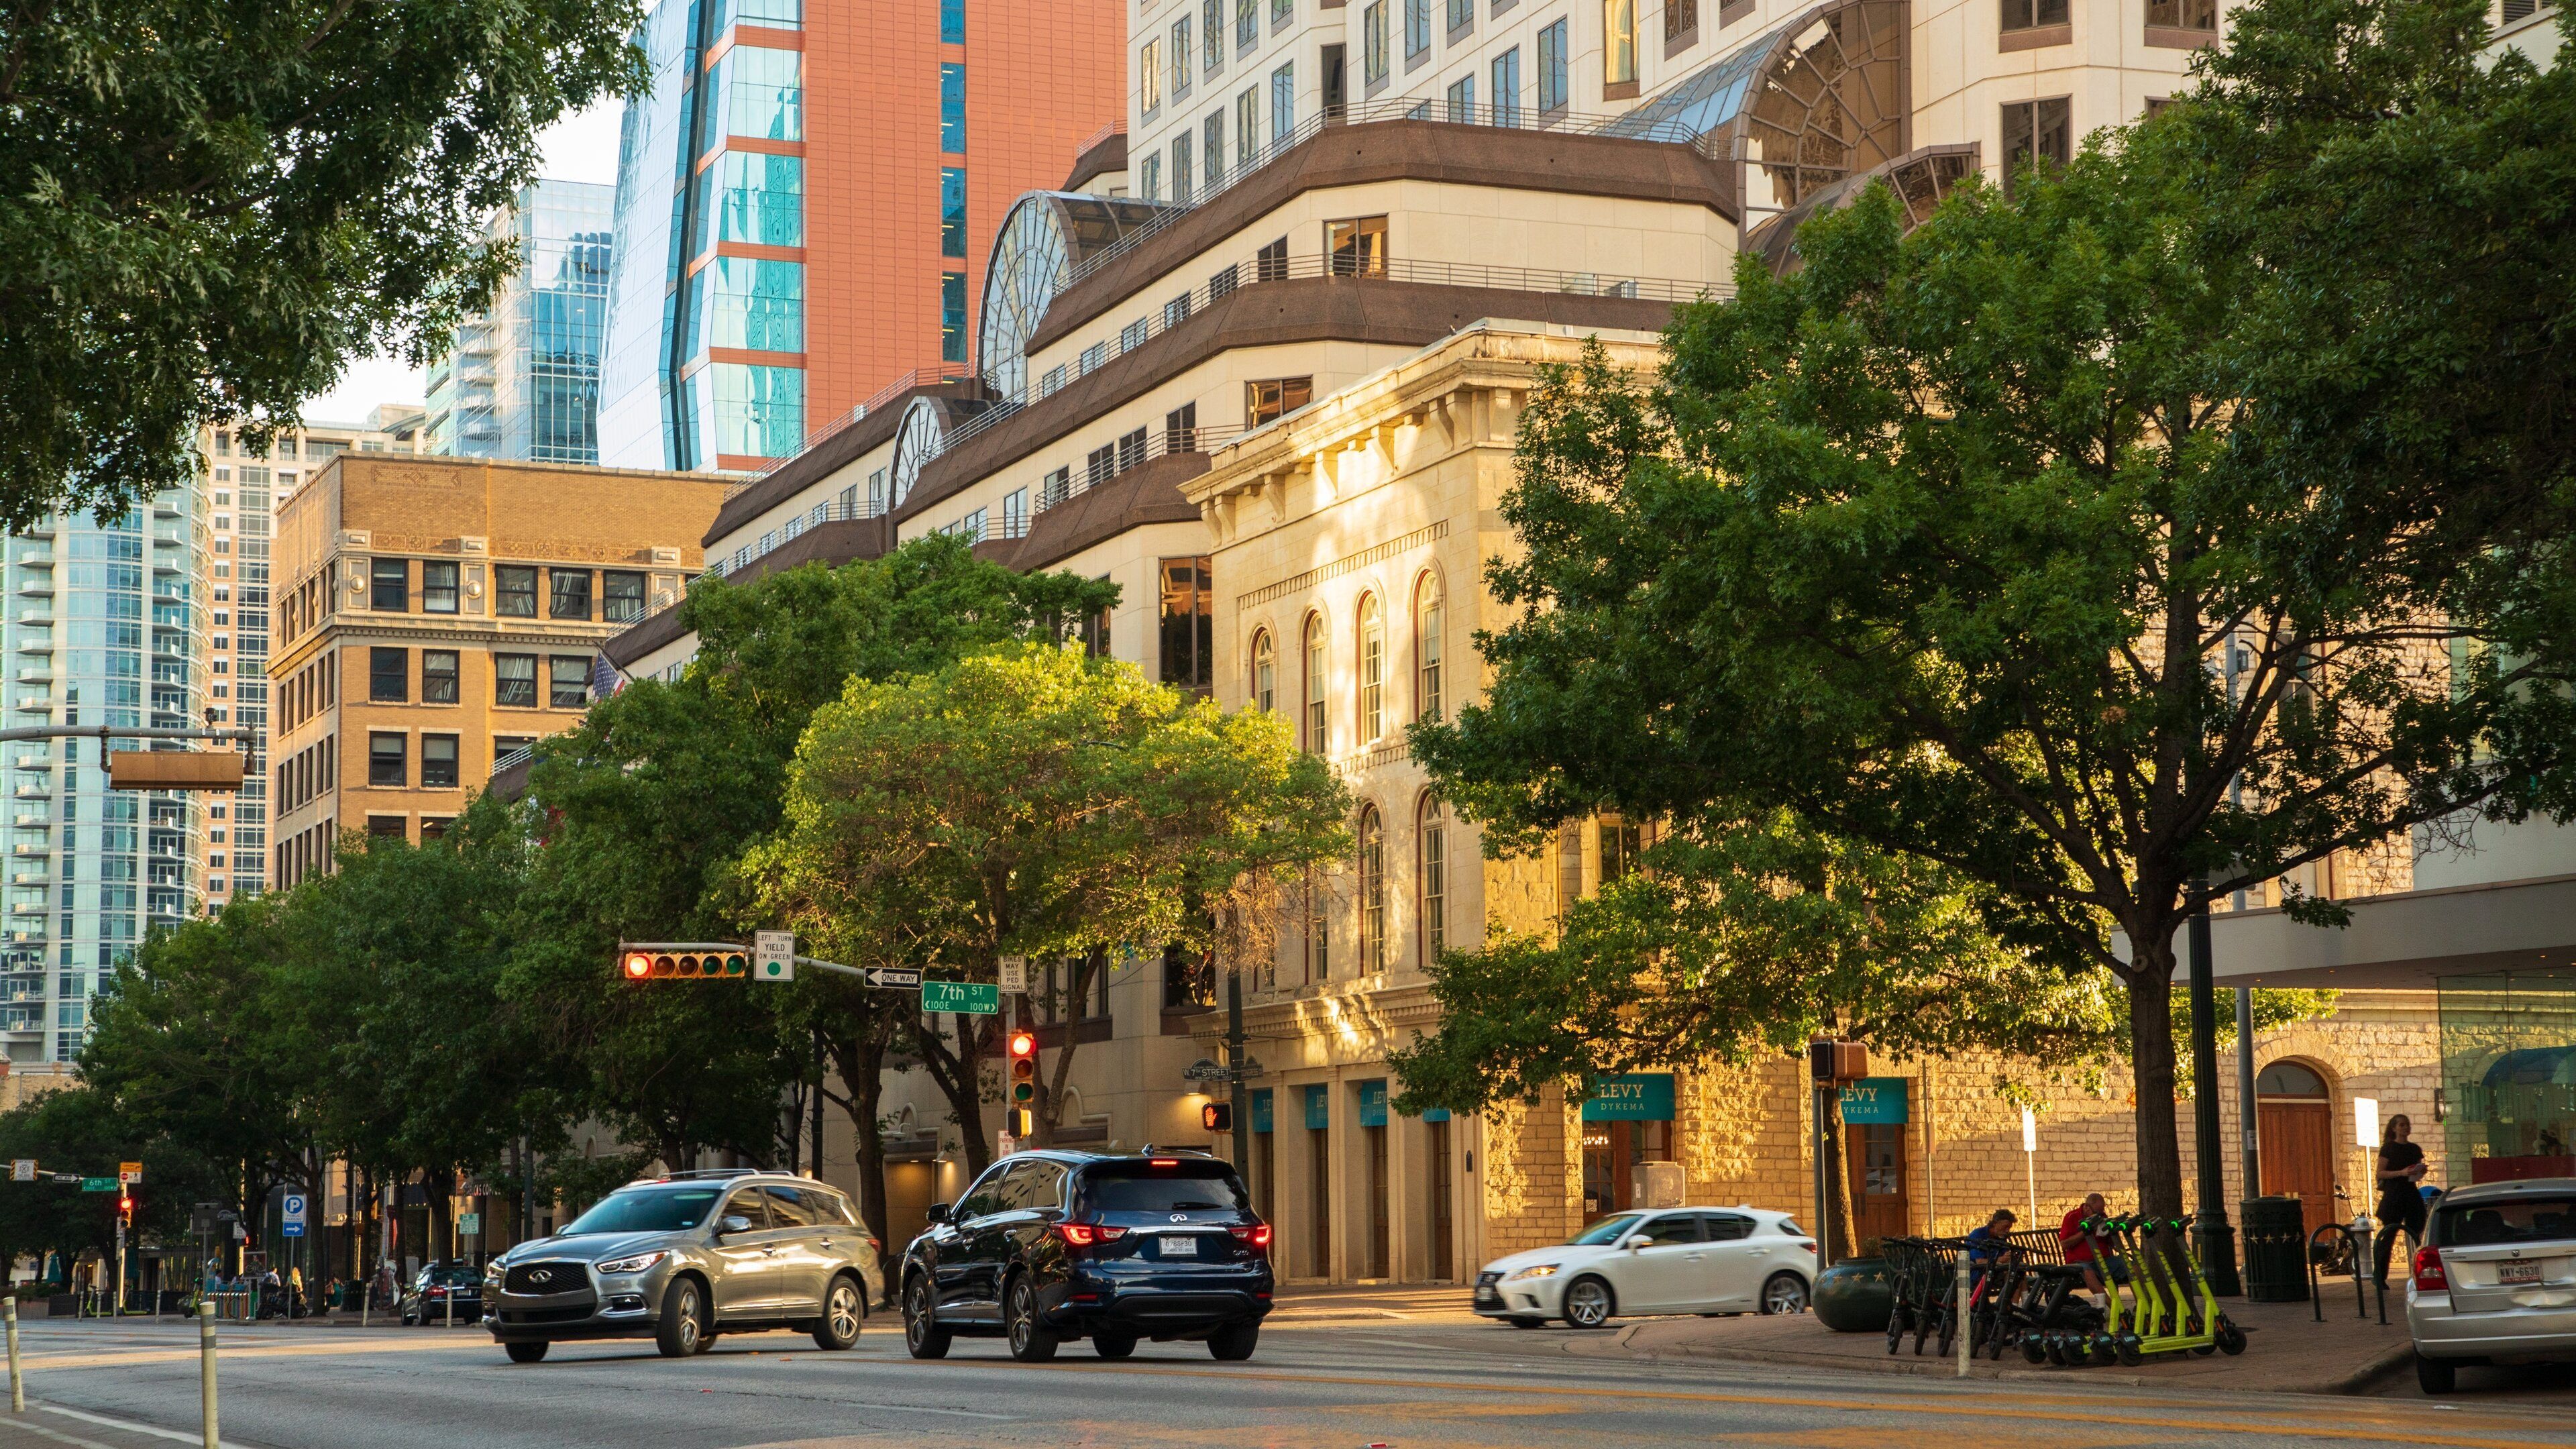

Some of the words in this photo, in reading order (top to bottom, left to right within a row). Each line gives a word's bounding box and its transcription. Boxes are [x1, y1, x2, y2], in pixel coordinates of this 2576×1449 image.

[765, 943, 785, 951] YIELD
[881, 974, 897, 982] ONE
[900, 975, 916, 983] WAY
[938, 984, 965, 1000] 7th
[971, 986, 983, 996] ST
[1201, 1068, 1229, 1077] STREET
[1600, 1083, 1644, 1098] LEVY
[1373, 1091, 1387, 1104] LEV
[289, 1199, 300, 1212] P
